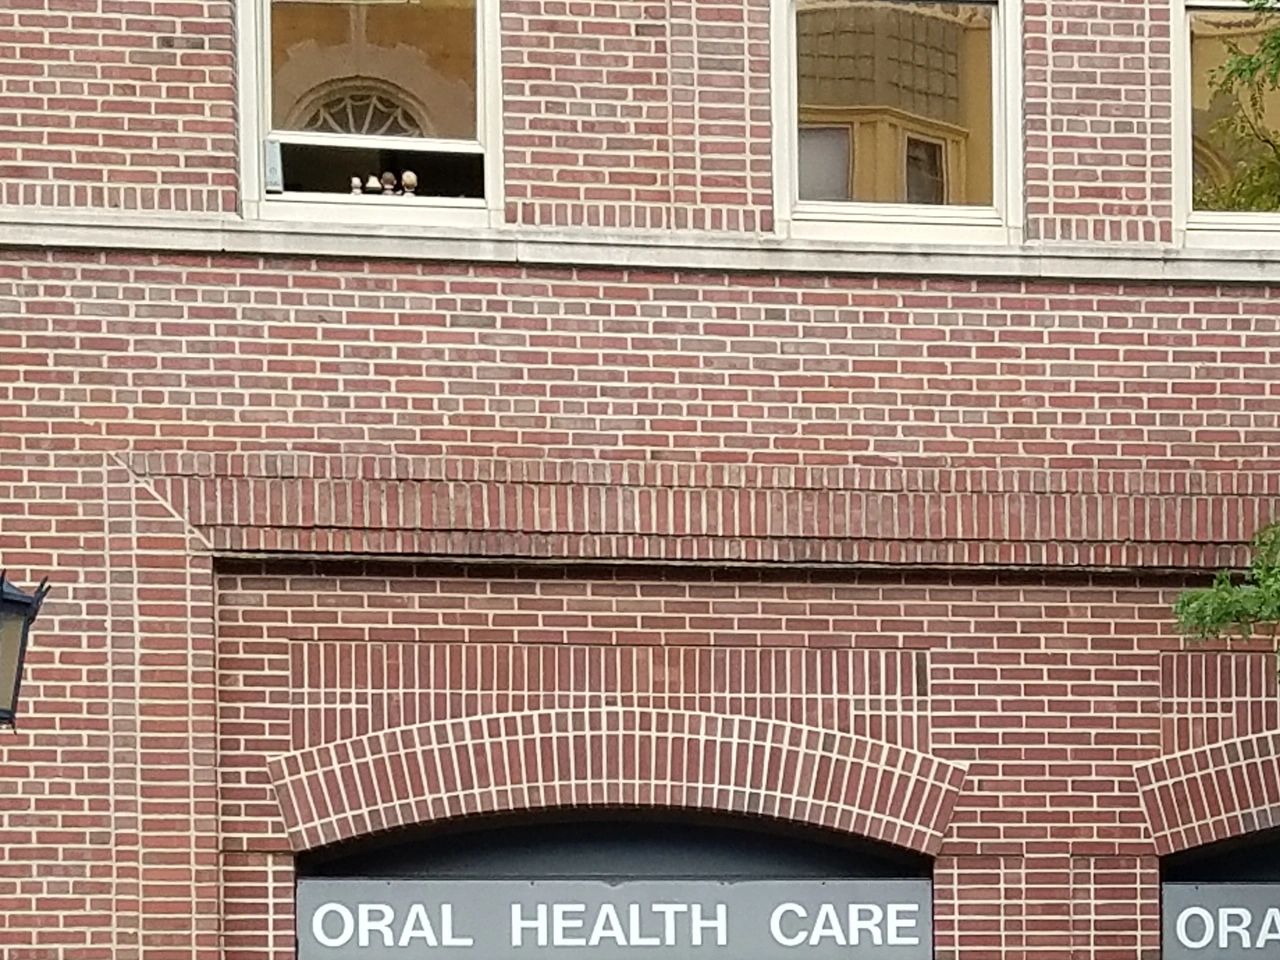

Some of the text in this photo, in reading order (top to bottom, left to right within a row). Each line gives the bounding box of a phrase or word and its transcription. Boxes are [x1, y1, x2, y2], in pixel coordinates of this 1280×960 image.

[311, 901, 920, 947] ORAL HEALTH CARE
